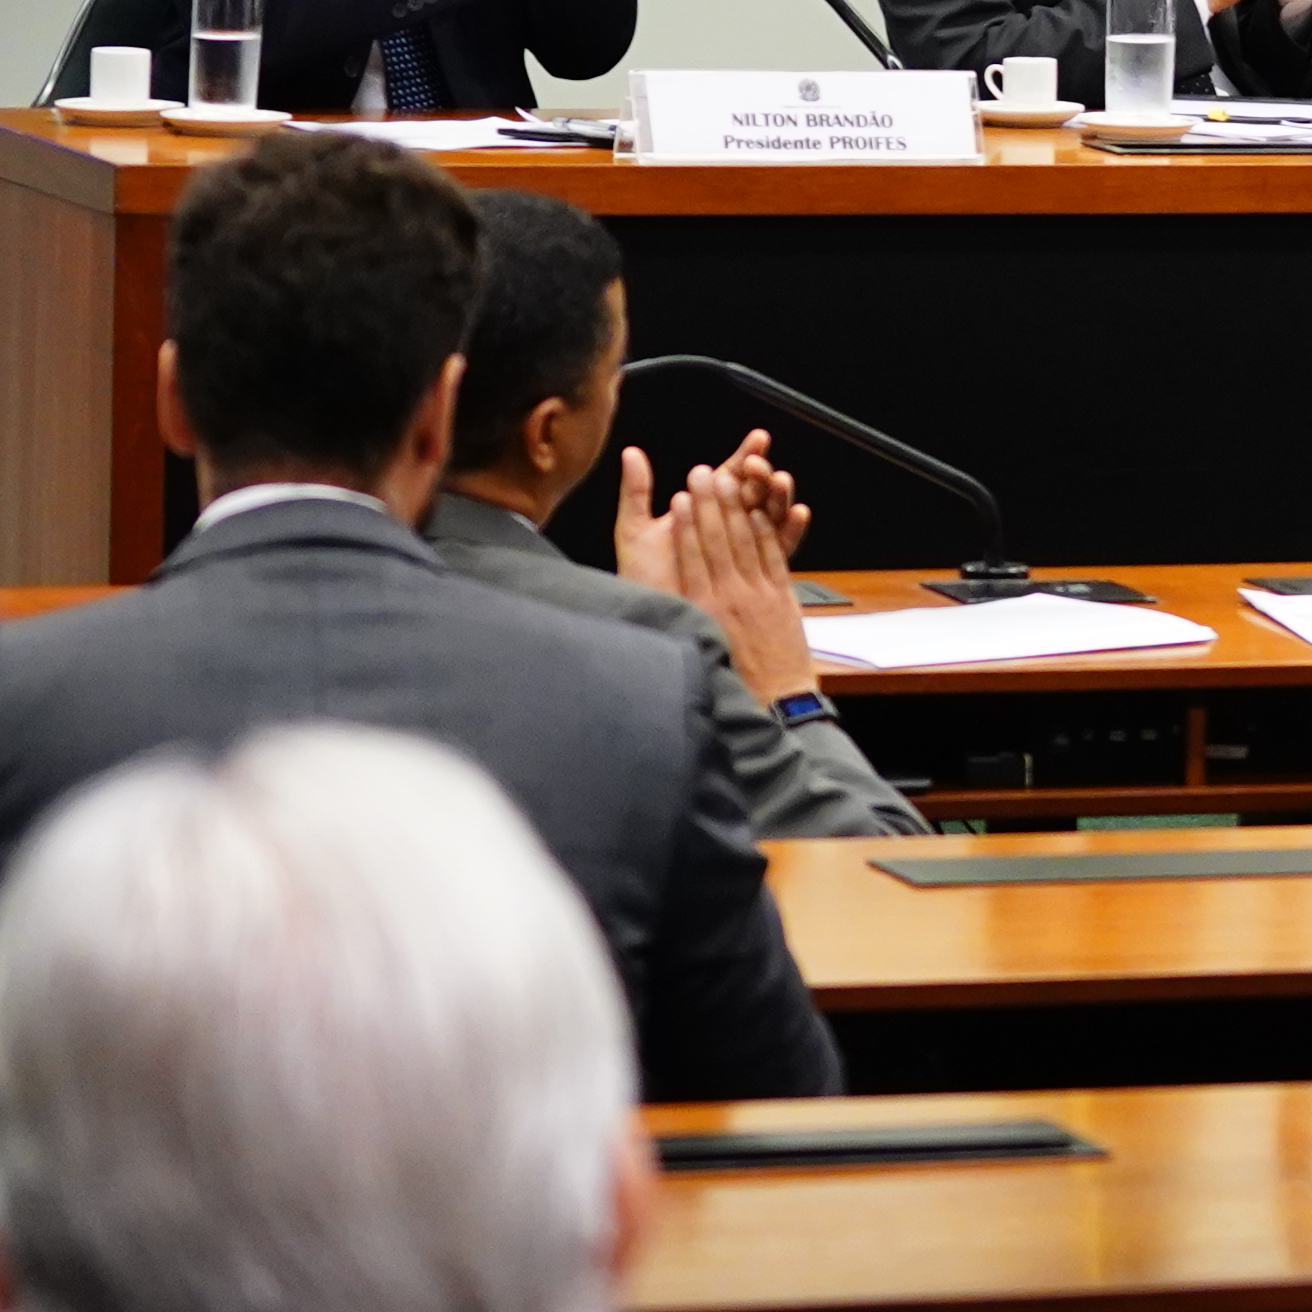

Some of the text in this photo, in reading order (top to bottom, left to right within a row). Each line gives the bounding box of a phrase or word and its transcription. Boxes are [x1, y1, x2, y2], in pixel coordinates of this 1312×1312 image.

[731, 110, 894, 129] NILTON BRANDÃO
[723, 134, 908, 151] Presidente PROIFES
